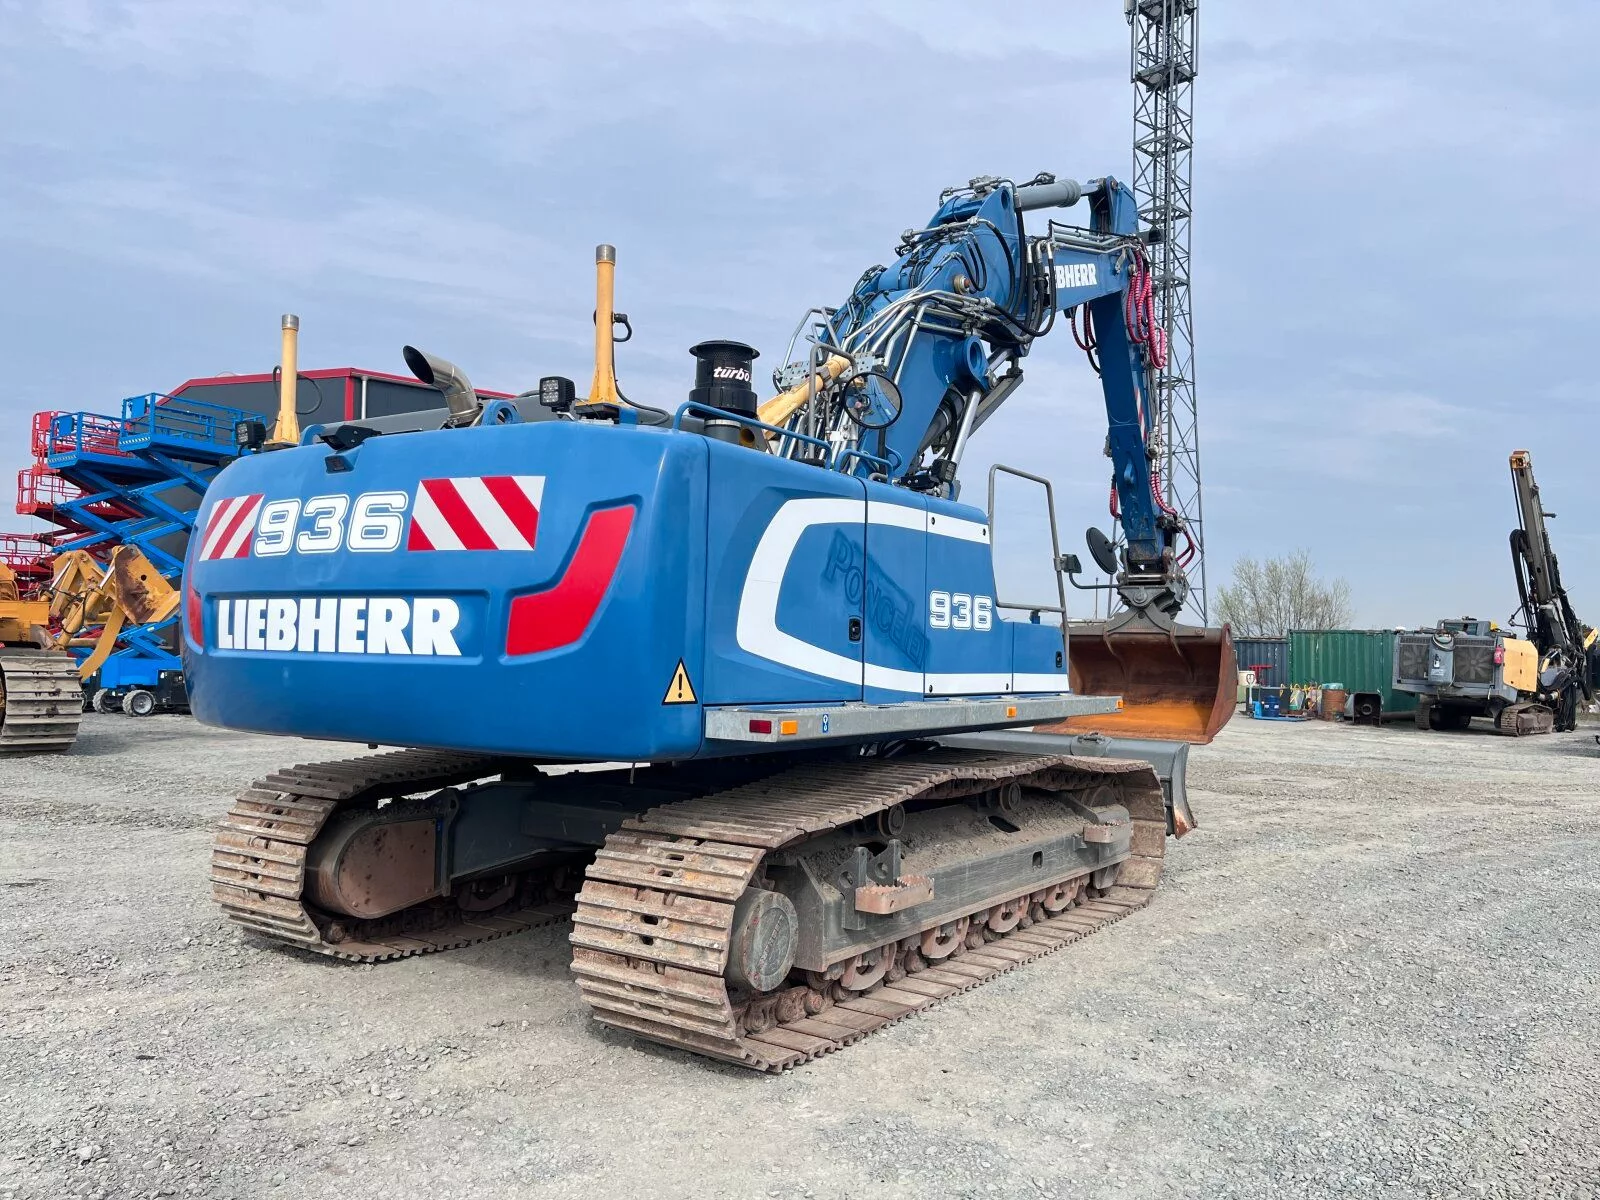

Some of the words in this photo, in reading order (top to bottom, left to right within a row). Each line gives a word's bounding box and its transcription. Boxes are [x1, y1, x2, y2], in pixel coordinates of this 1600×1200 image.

[713, 366, 750, 382] turbo
[254, 490, 409, 557] 936
[218, 597, 462, 656] LIEBHERR
[930, 590, 993, 632] 936
